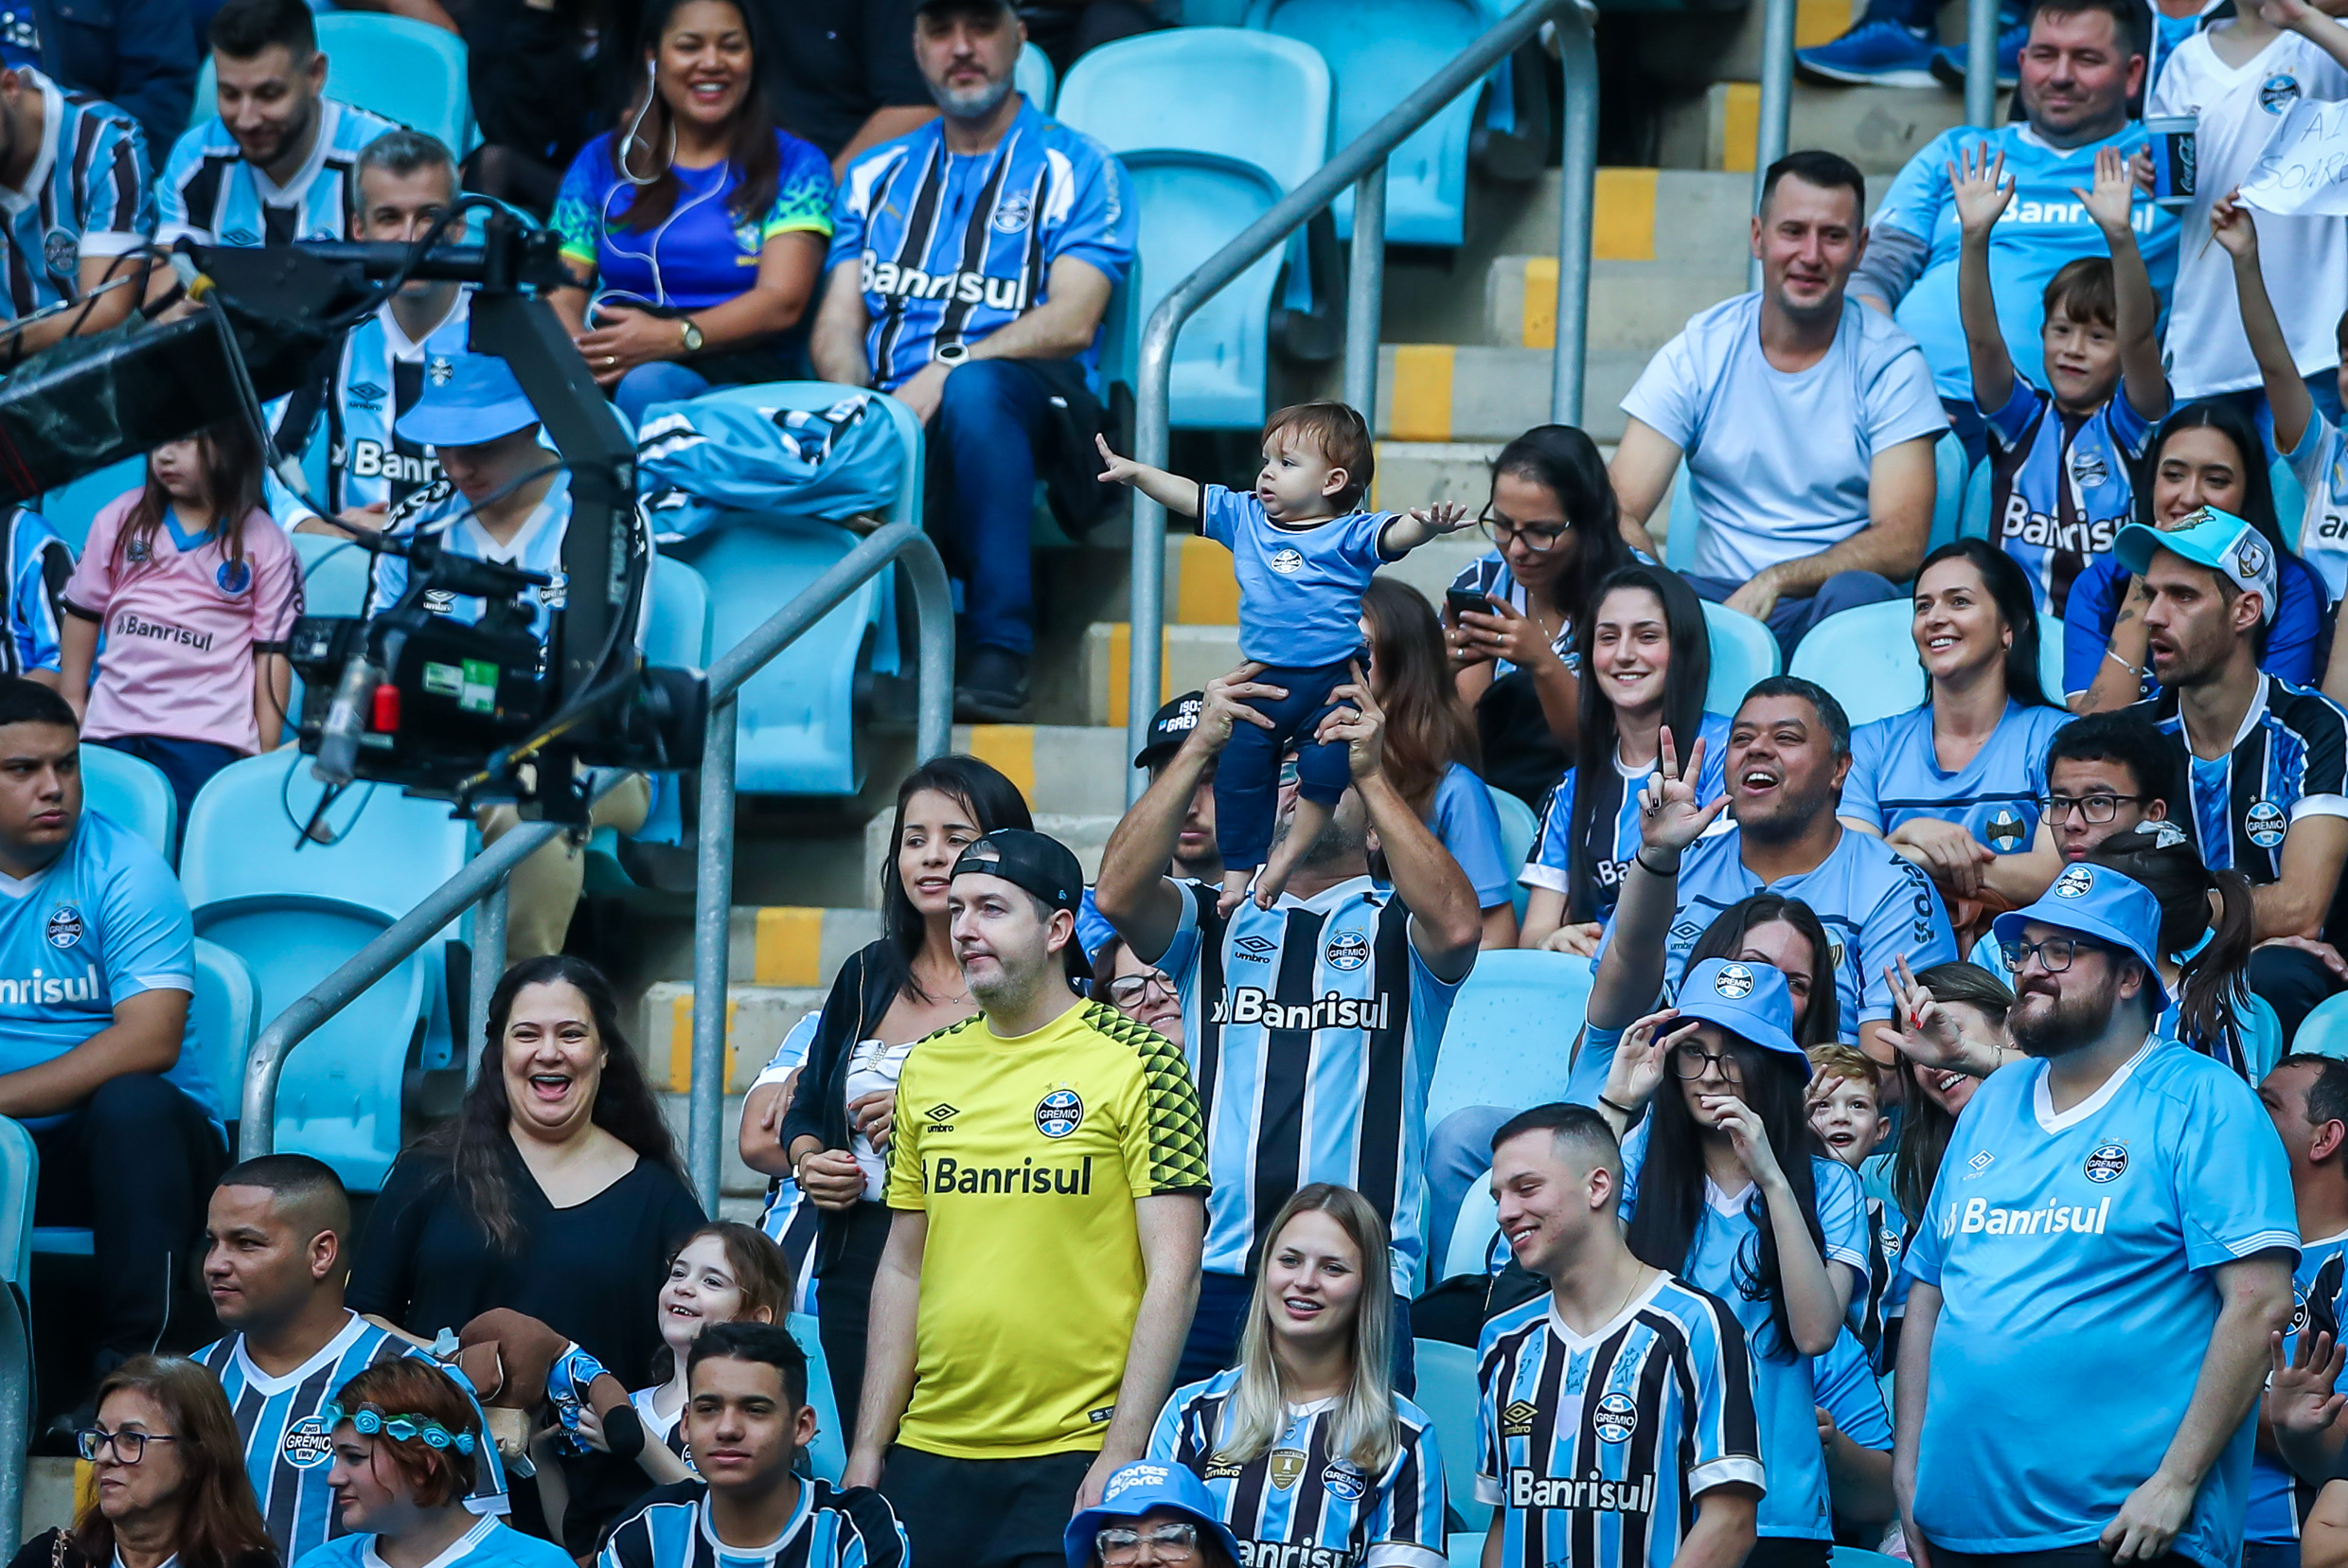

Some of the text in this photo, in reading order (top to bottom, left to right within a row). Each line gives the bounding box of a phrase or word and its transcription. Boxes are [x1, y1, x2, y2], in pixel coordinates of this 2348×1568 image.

[126, 615, 214, 652] Banrisul
[1235, 952, 1271, 964] umbro
[1234, 987, 1390, 1030] Banrisul
[927, 1123, 954, 1133] umbro
[934, 1156, 1093, 1196] Banrisul
[1960, 1196, 2111, 1236] Banrisul
[1204, 1467, 1241, 1479] umbro
[1512, 1468, 1653, 1514] Banrisul
